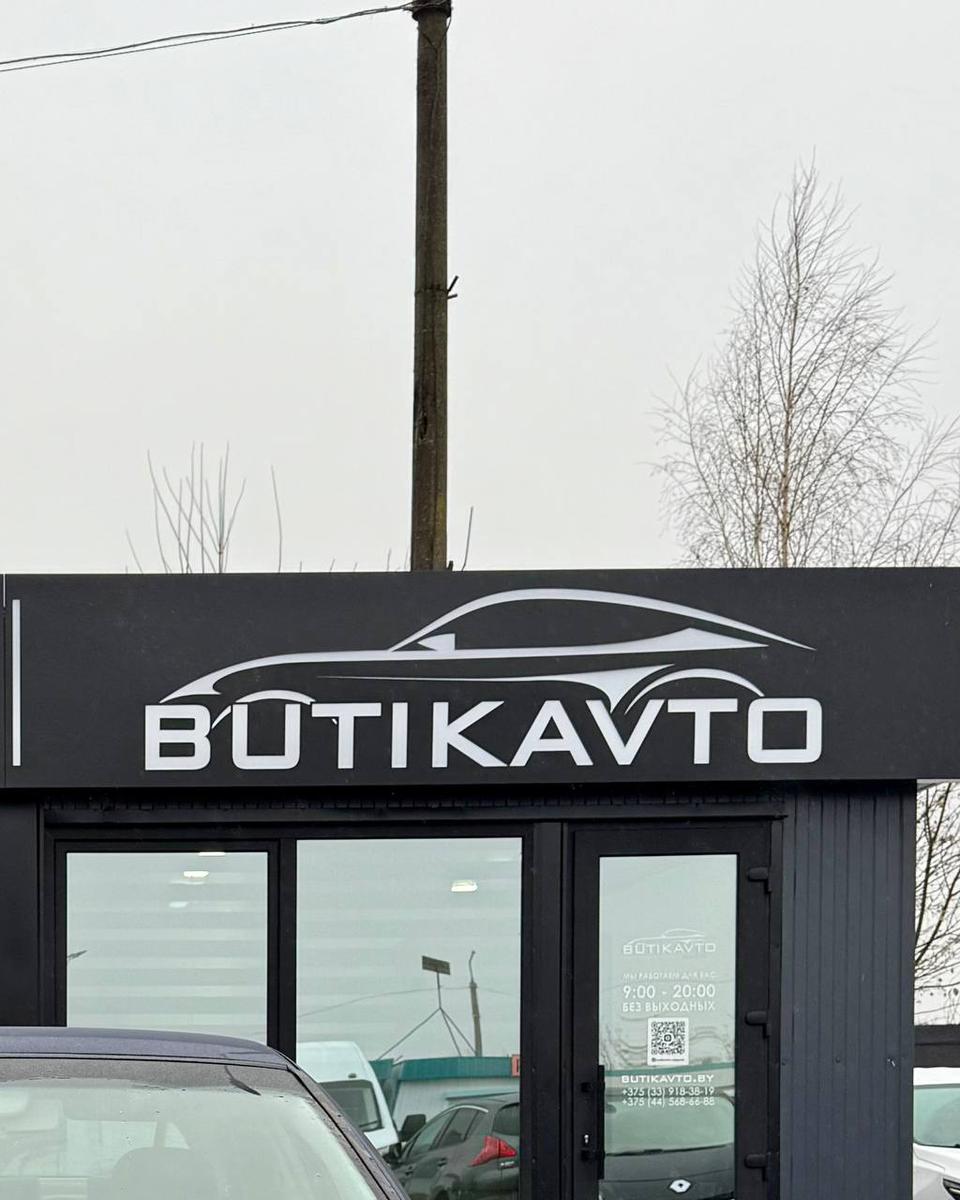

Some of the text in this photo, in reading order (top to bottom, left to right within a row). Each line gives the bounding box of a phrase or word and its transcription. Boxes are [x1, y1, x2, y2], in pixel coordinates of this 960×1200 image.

[144, 696, 823, 771] BUTIKAVTO
[623, 943, 716, 955] BUTIKAVTO
[623, 985, 655, 999] 9:00
[673, 984, 716, 998] 20:00
[622, 1000, 715, 1013] БЕЗ ВЫХОДНЫХ
[621, 1074, 714, 1084] BUTIKAVTO.BY
[622, 1086, 715, 1098] +375 (33) 918-38-19
[622, 1097, 715, 1108] +375 (44) 568-66-88
